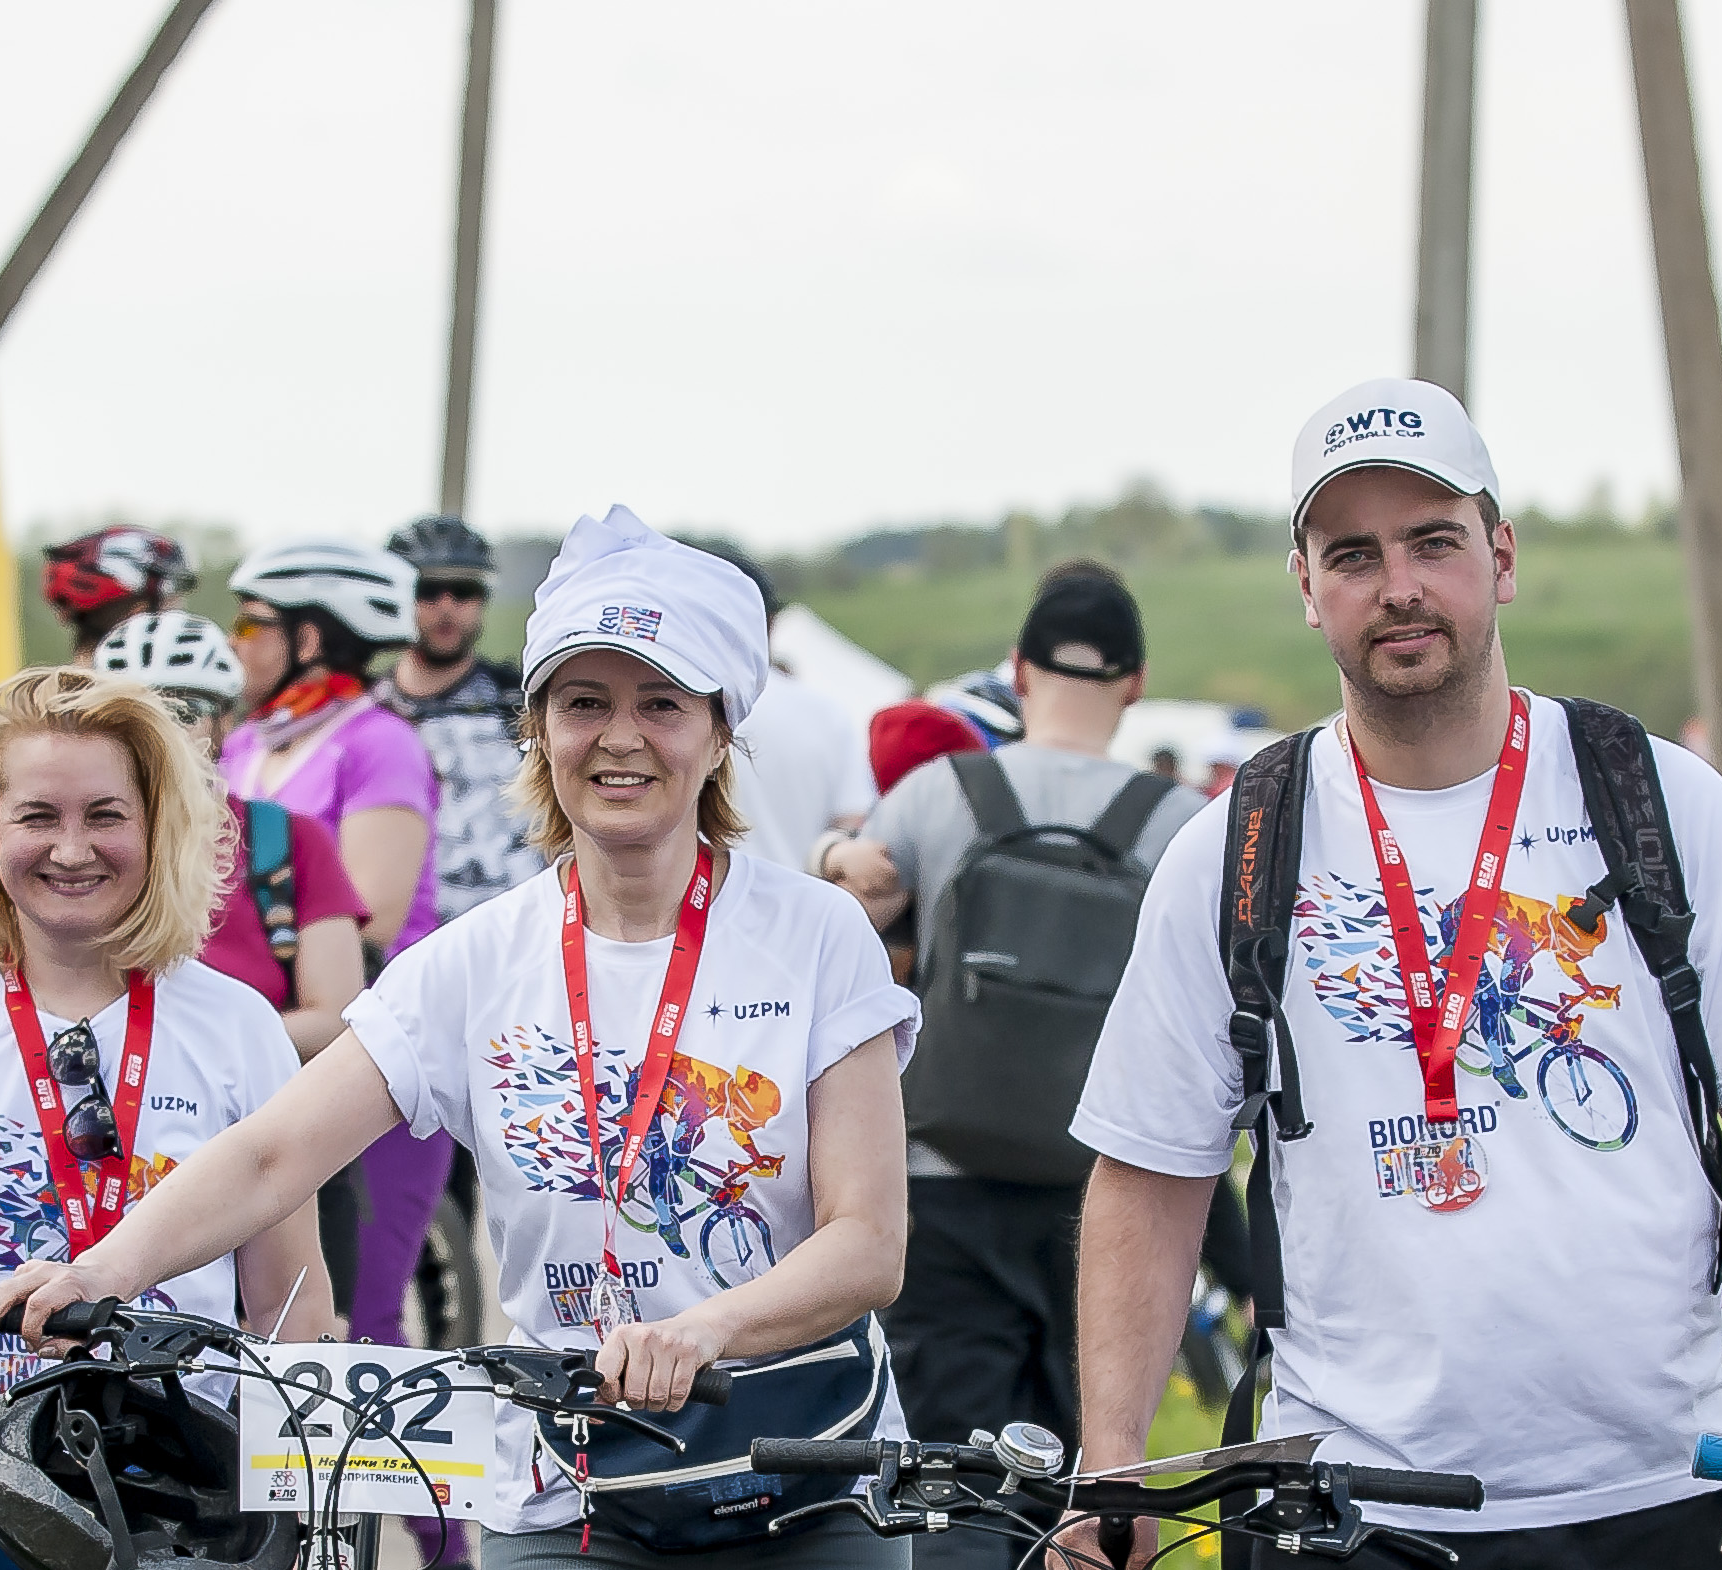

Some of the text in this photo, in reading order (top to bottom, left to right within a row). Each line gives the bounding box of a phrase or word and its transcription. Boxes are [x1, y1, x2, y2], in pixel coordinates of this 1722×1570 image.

[1347, 408, 1422, 433] WTG
[1324, 429, 1425, 457] FOOTBALL CUP
[1547, 826, 1597, 845] UPM
[735, 1001, 790, 1019] UZPM
[150, 1096, 198, 1116] UZPM
[544, 1260, 659, 1290] BIONRD
[279, 1362, 453, 1444] 282
[319, 1457, 377, 1468] Ноички
[382, 1459, 398, 1469] 15
[319, 1472, 419, 1485] ВЕОПРИТЯЖЕНИЕ
[713, 1498, 759, 1516] element
